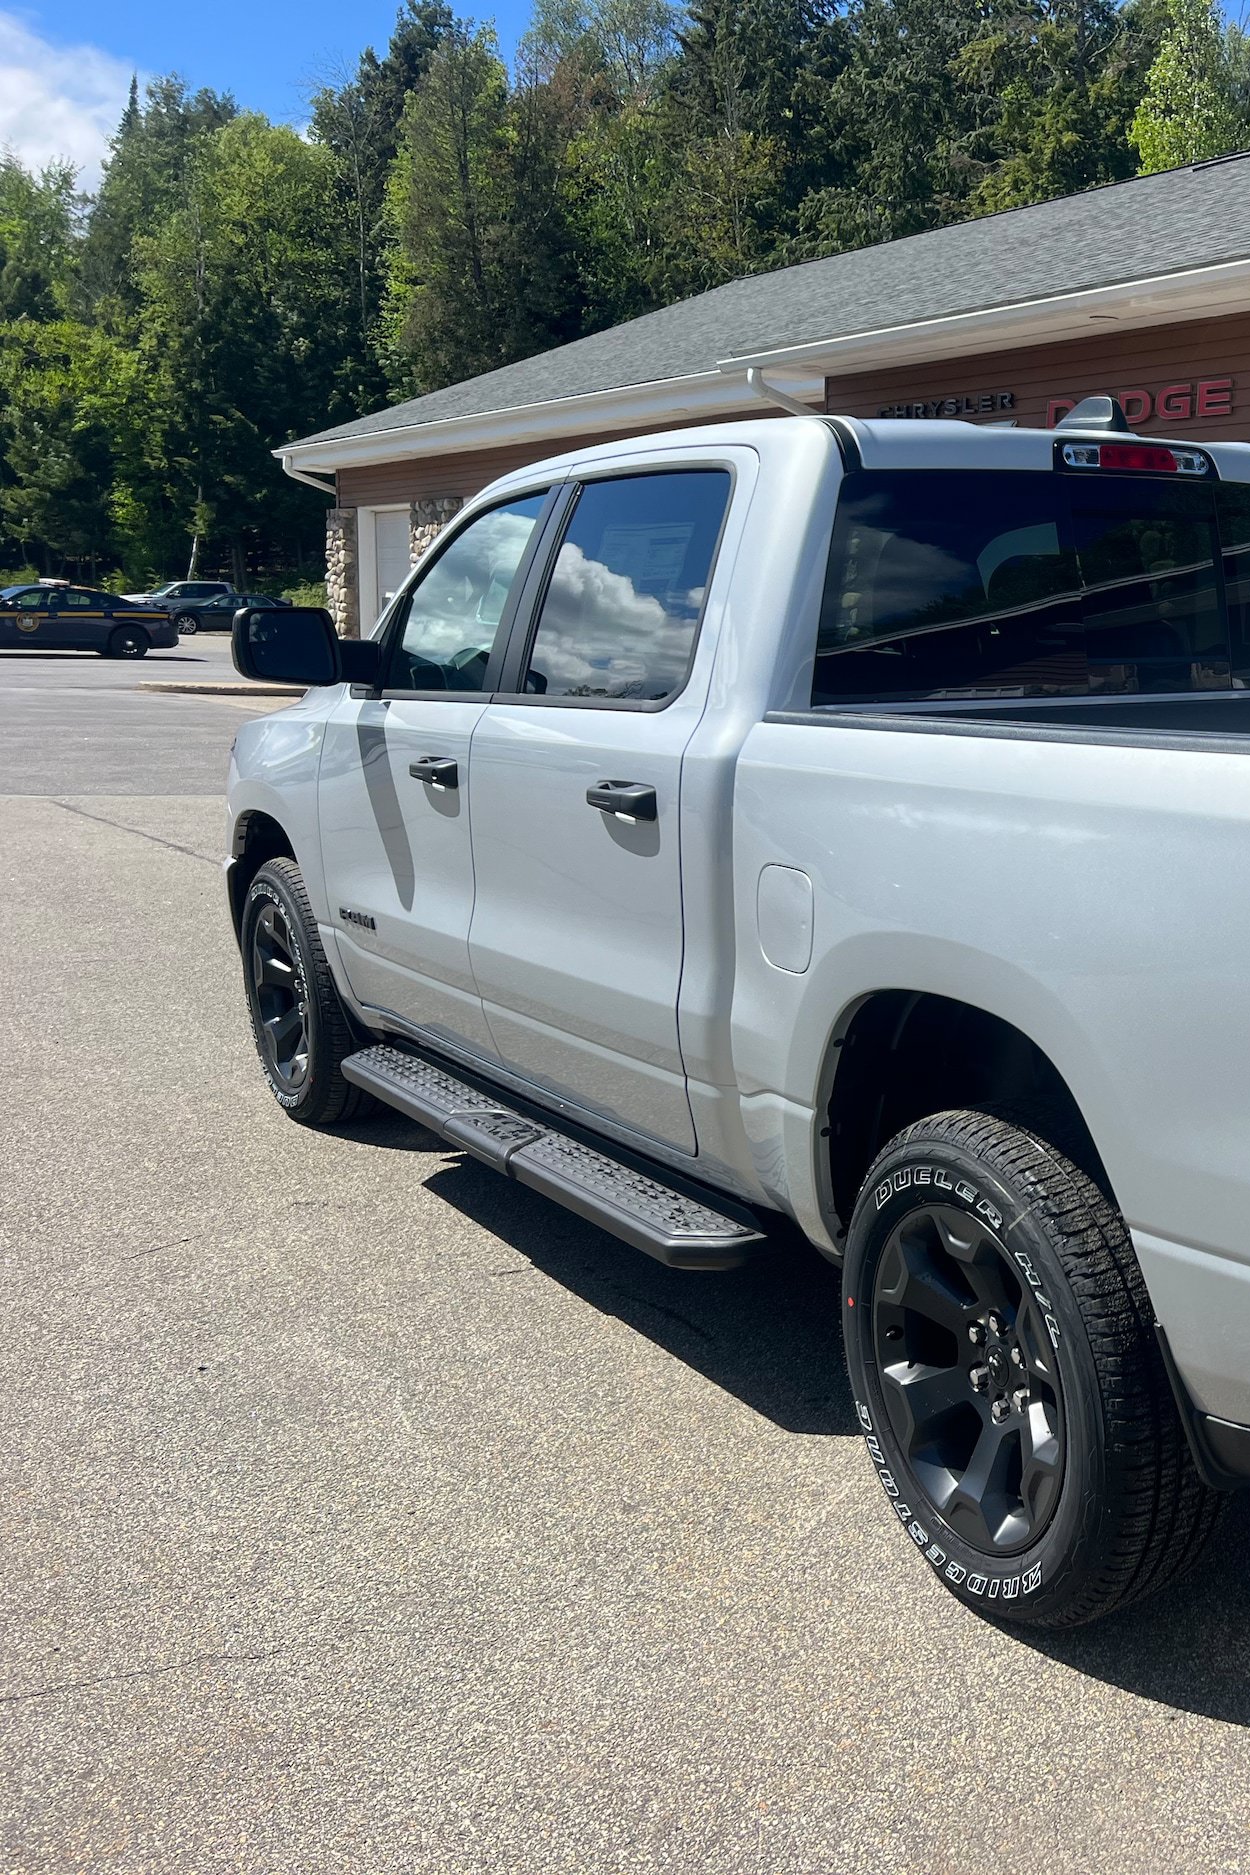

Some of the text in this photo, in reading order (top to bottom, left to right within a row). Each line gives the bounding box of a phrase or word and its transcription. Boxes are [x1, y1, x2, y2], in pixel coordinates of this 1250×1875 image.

[1046, 379, 1232, 430] DDGE
[874, 1166, 1003, 1230] DUELER
[855, 1400, 1042, 1599] BRIDGESTONE
